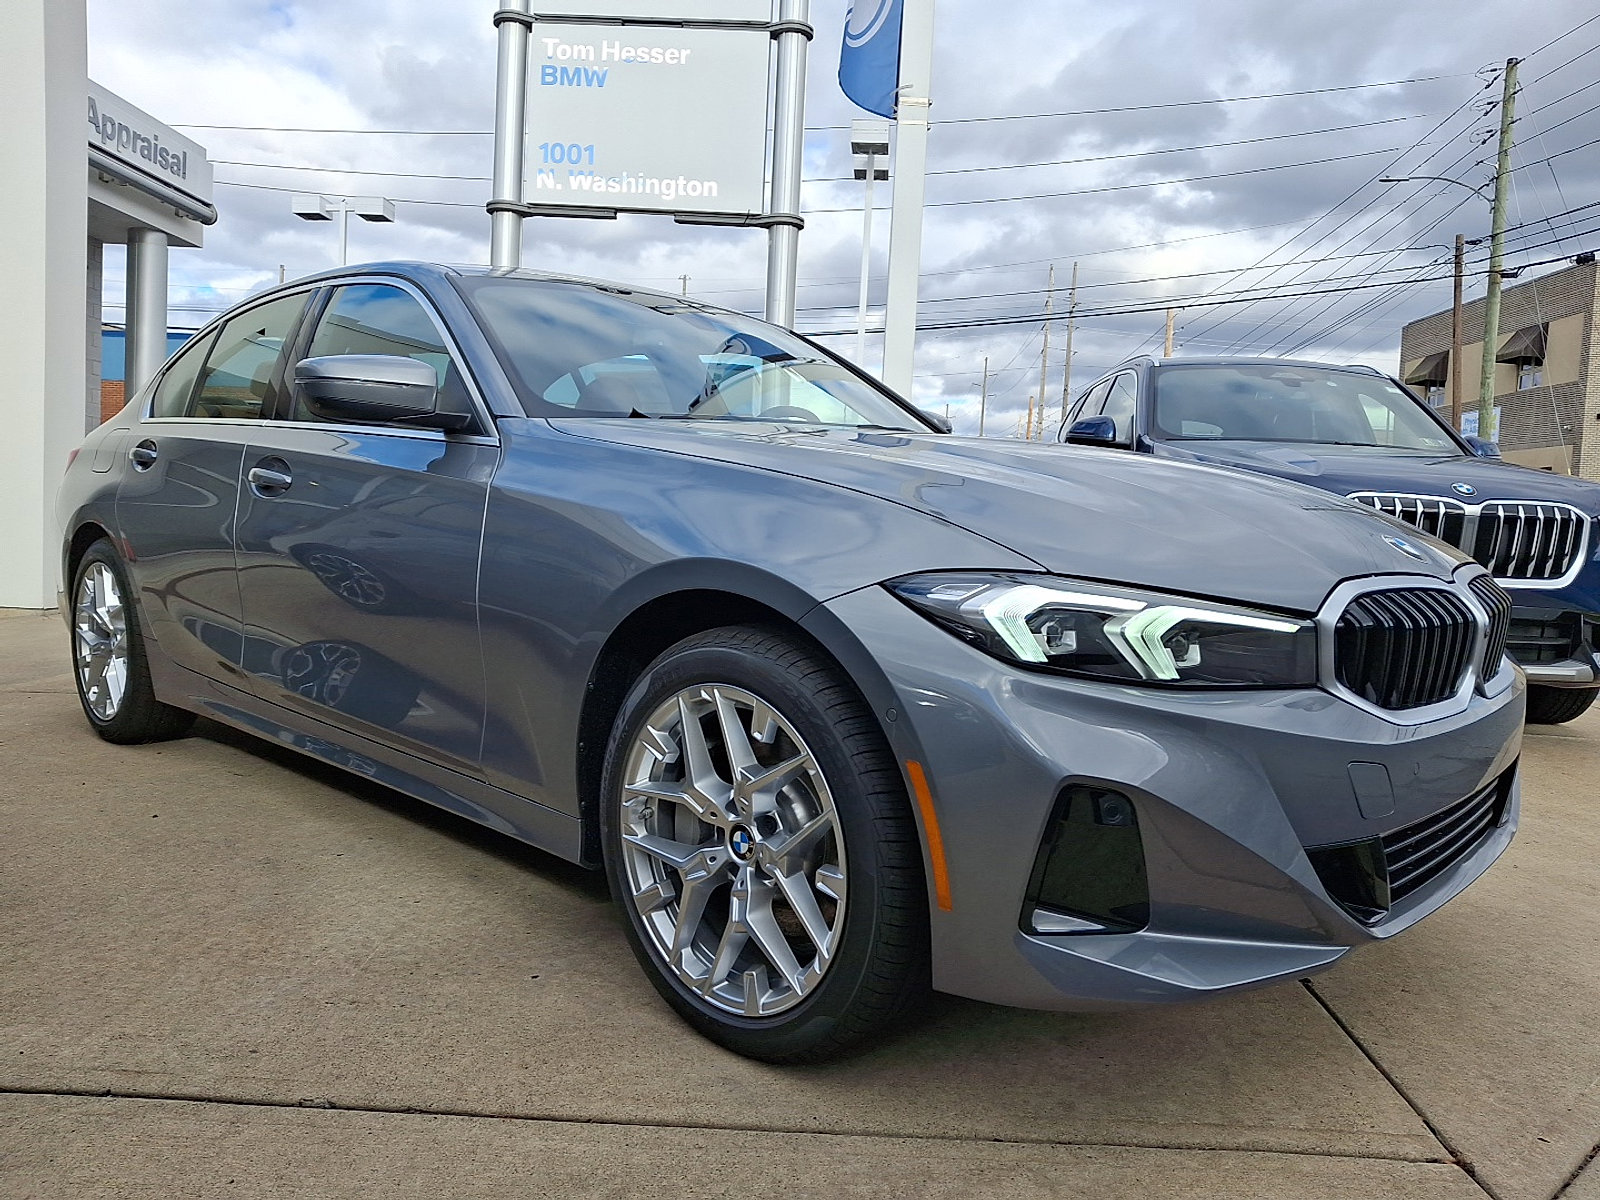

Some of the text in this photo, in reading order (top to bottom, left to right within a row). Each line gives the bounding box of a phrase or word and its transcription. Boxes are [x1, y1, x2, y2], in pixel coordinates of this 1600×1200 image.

[542, 38, 691, 65] Tom Hesser
[541, 65, 608, 87] BMW
[88, 95, 187, 179] Appraisal
[538, 142, 595, 165] 1001
[536, 168, 718, 200] N. Washington
